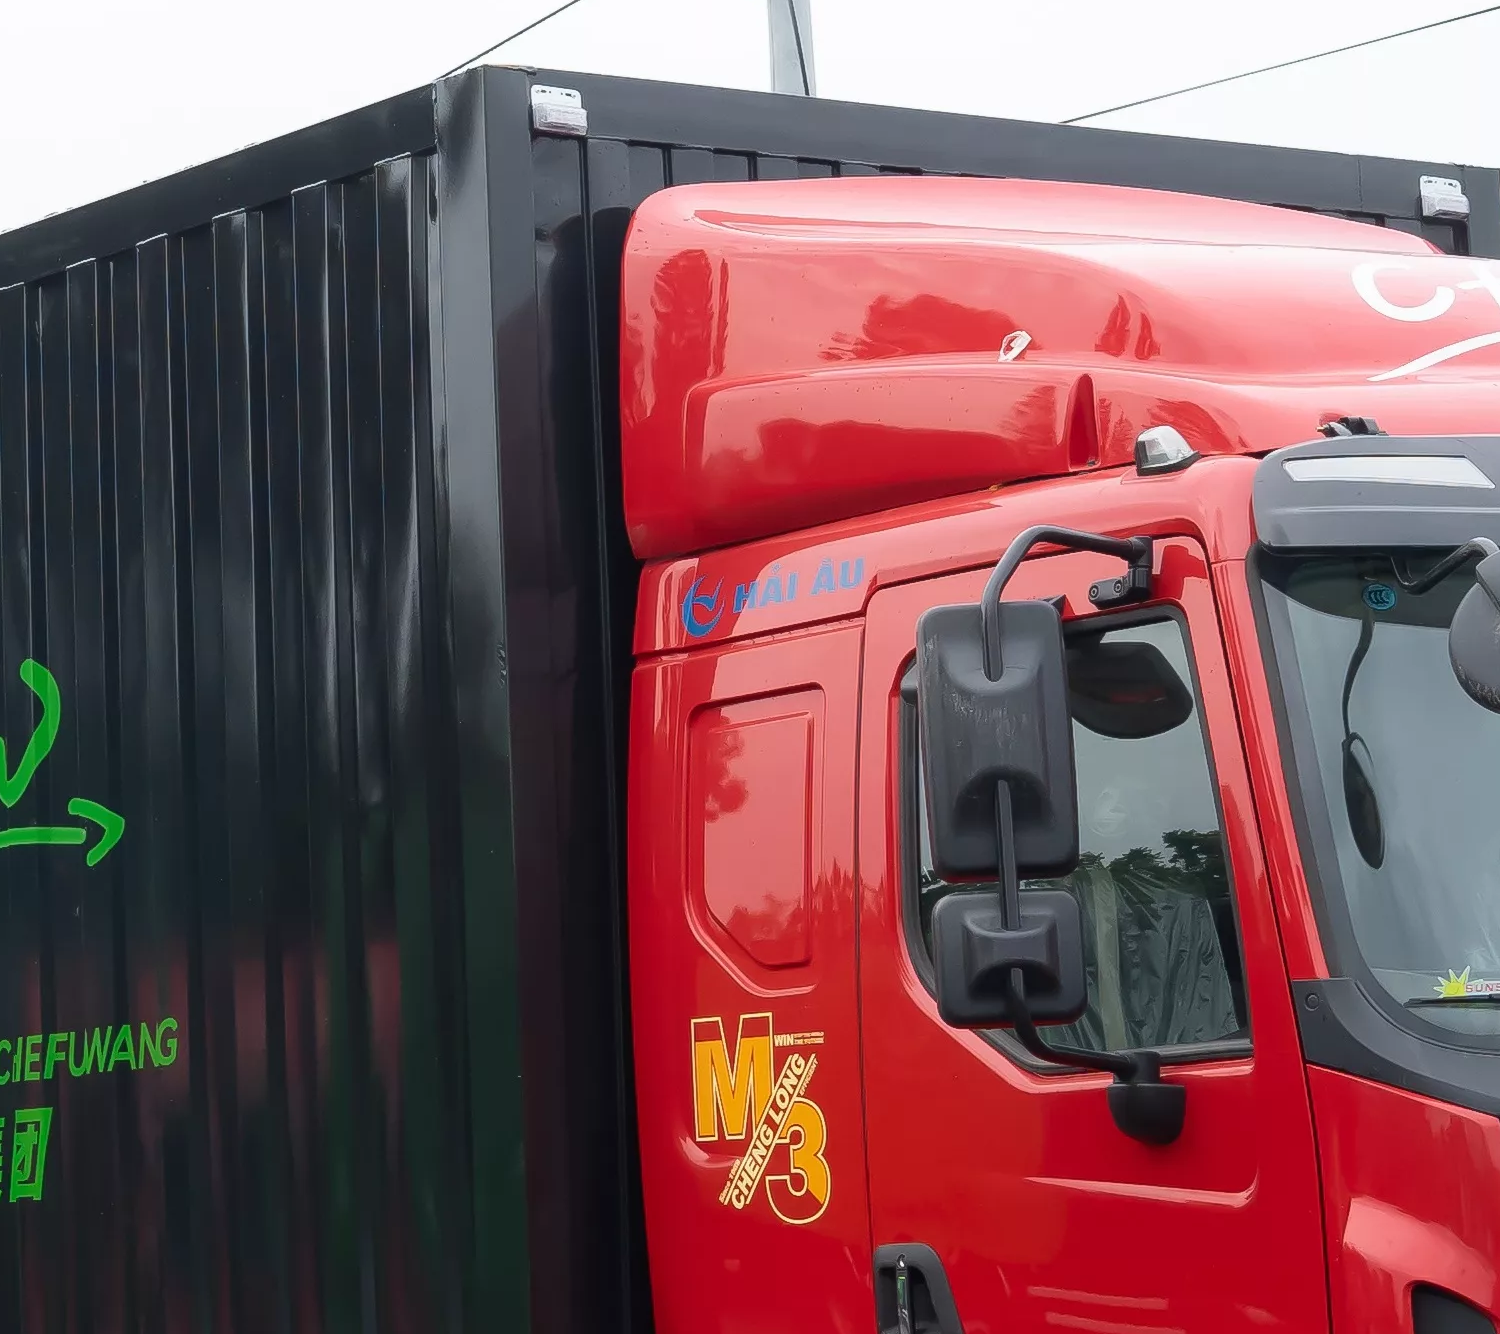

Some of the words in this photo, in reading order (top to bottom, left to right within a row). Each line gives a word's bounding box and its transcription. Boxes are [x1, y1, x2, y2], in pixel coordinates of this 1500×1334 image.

[732, 563, 798, 613] HẢI
[731, 1123, 774, 1210] CHENG
[768, 1053, 806, 1125] LONG
